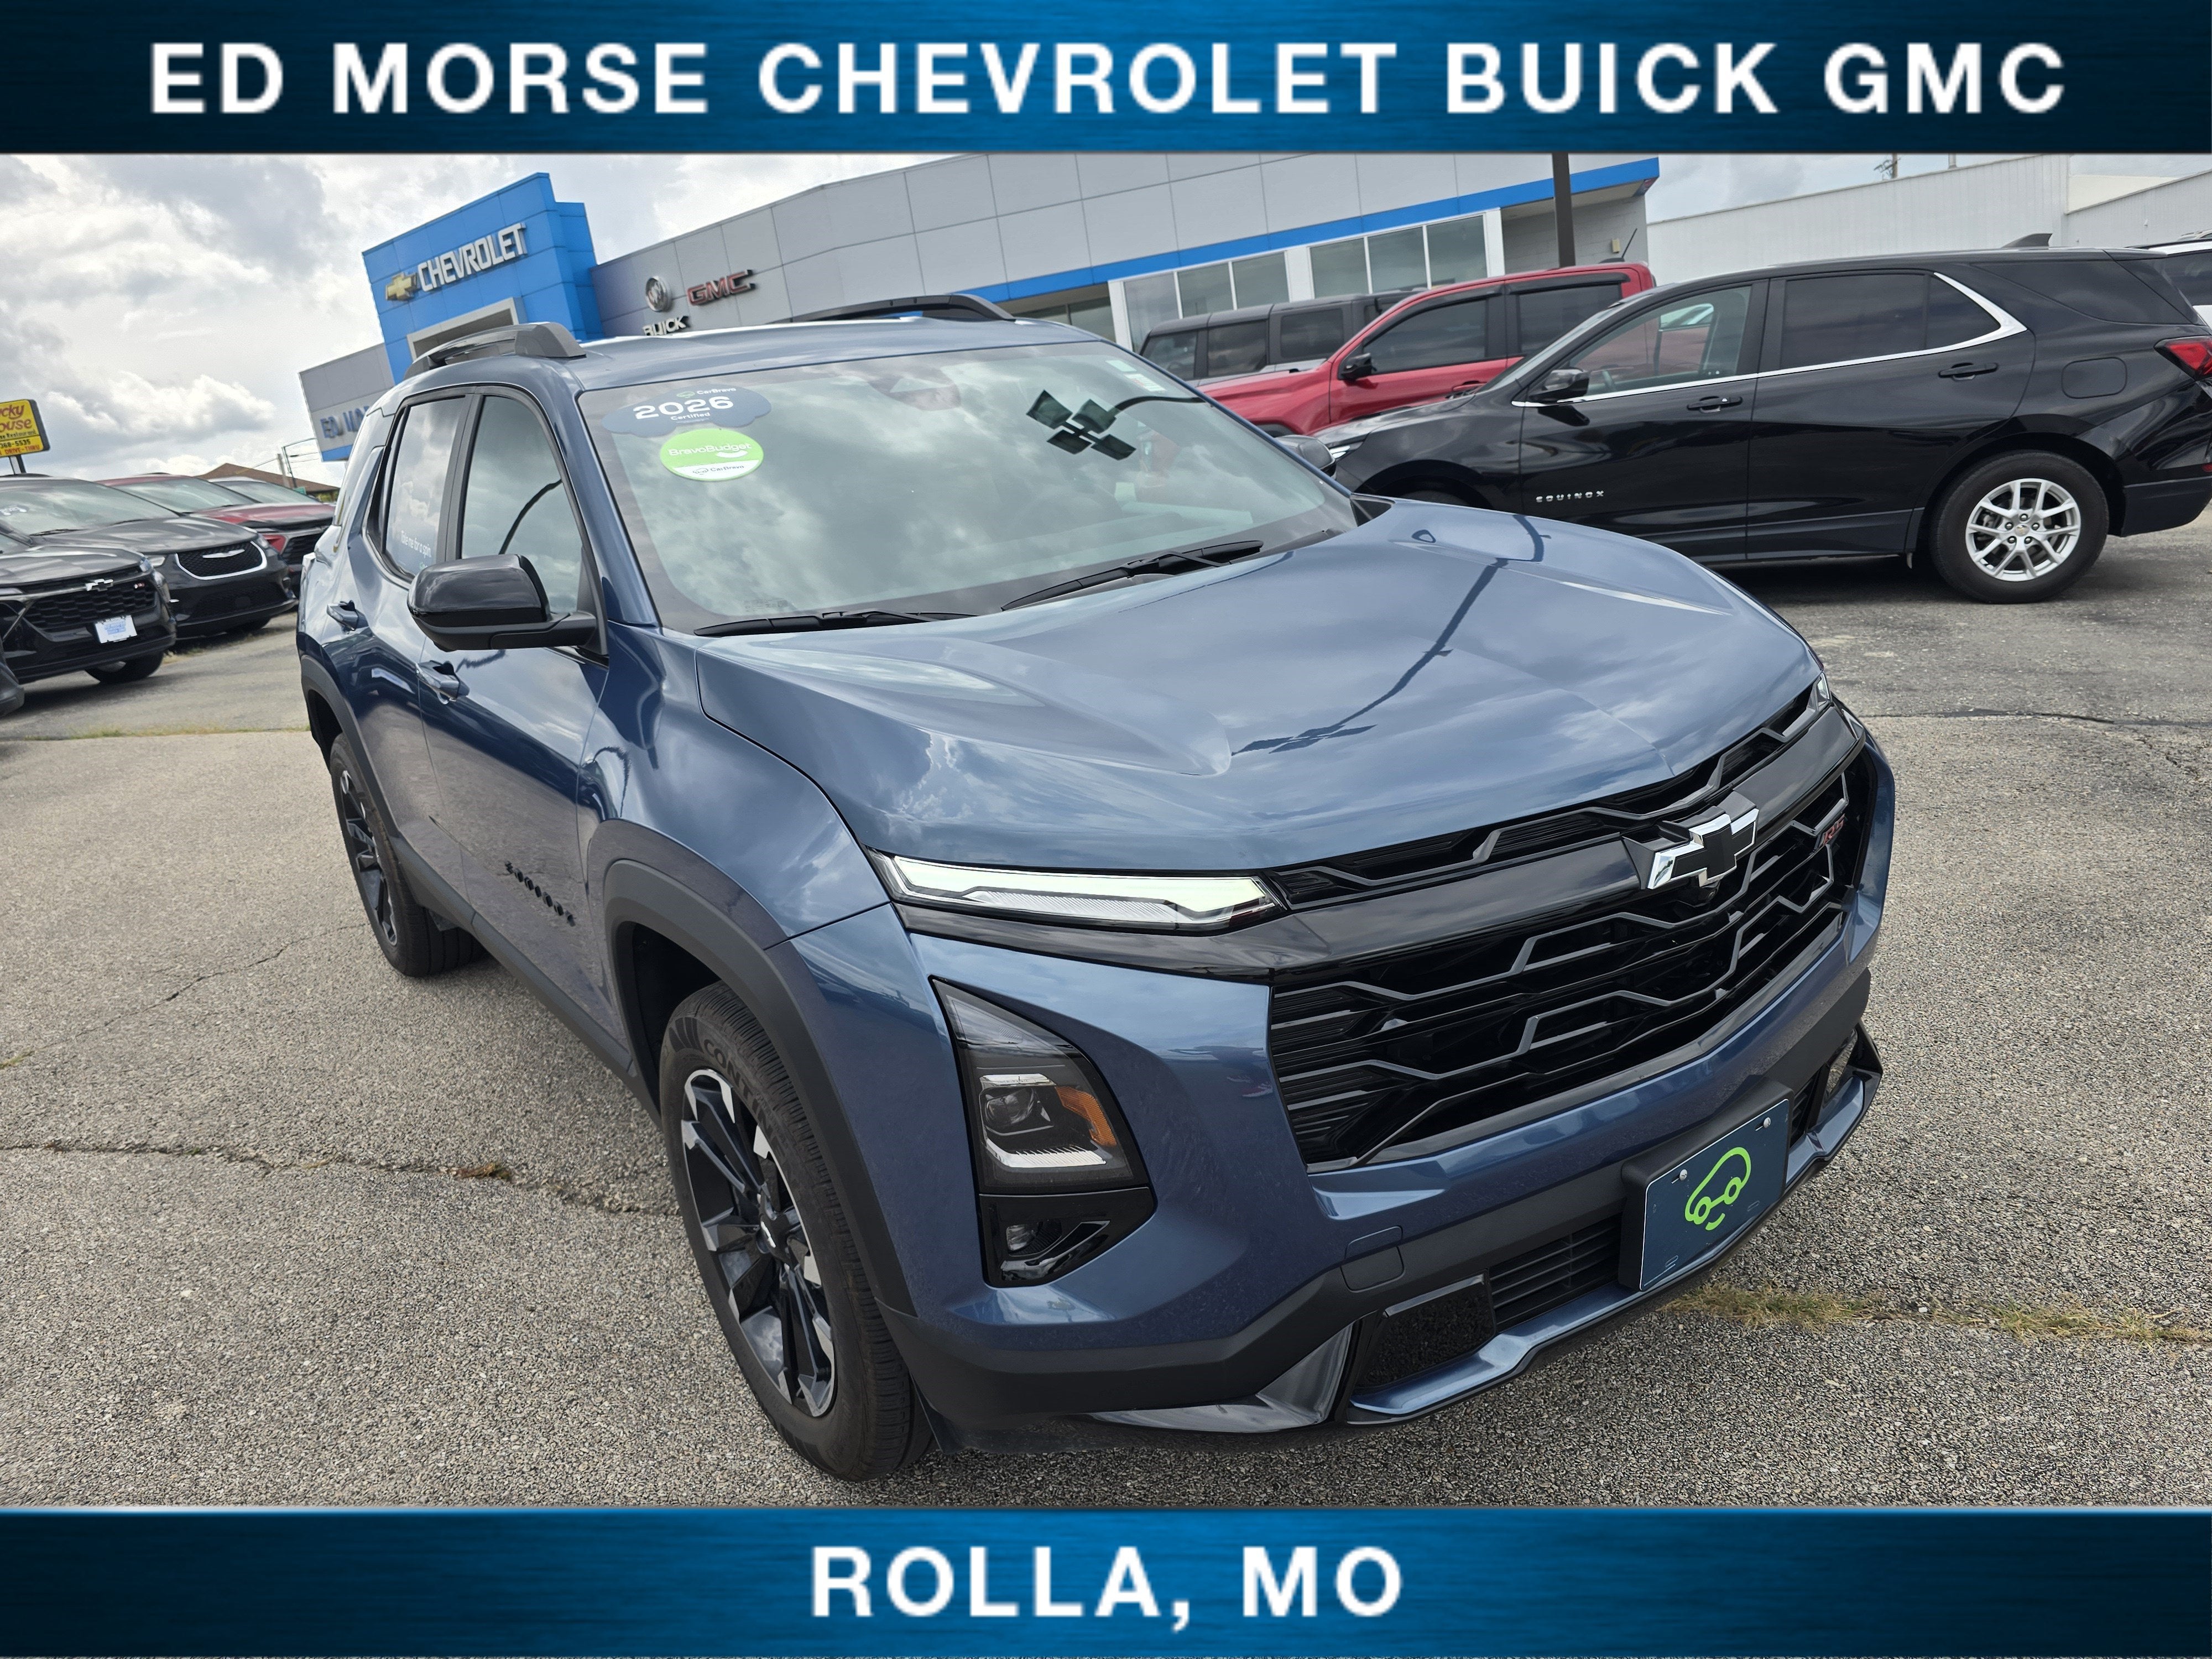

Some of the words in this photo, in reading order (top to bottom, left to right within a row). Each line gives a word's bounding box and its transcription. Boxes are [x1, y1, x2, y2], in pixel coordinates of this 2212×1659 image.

[418, 222, 527, 293] CHEVROLET
[687, 269, 754, 306] GMC
[0, 404, 25, 420] cky
[633, 395, 734, 420] 2026
[670, 412, 711, 420] Certified
[668, 443, 752, 456] BravoBudget
[1536, 490, 1604, 503] EQUINOX
